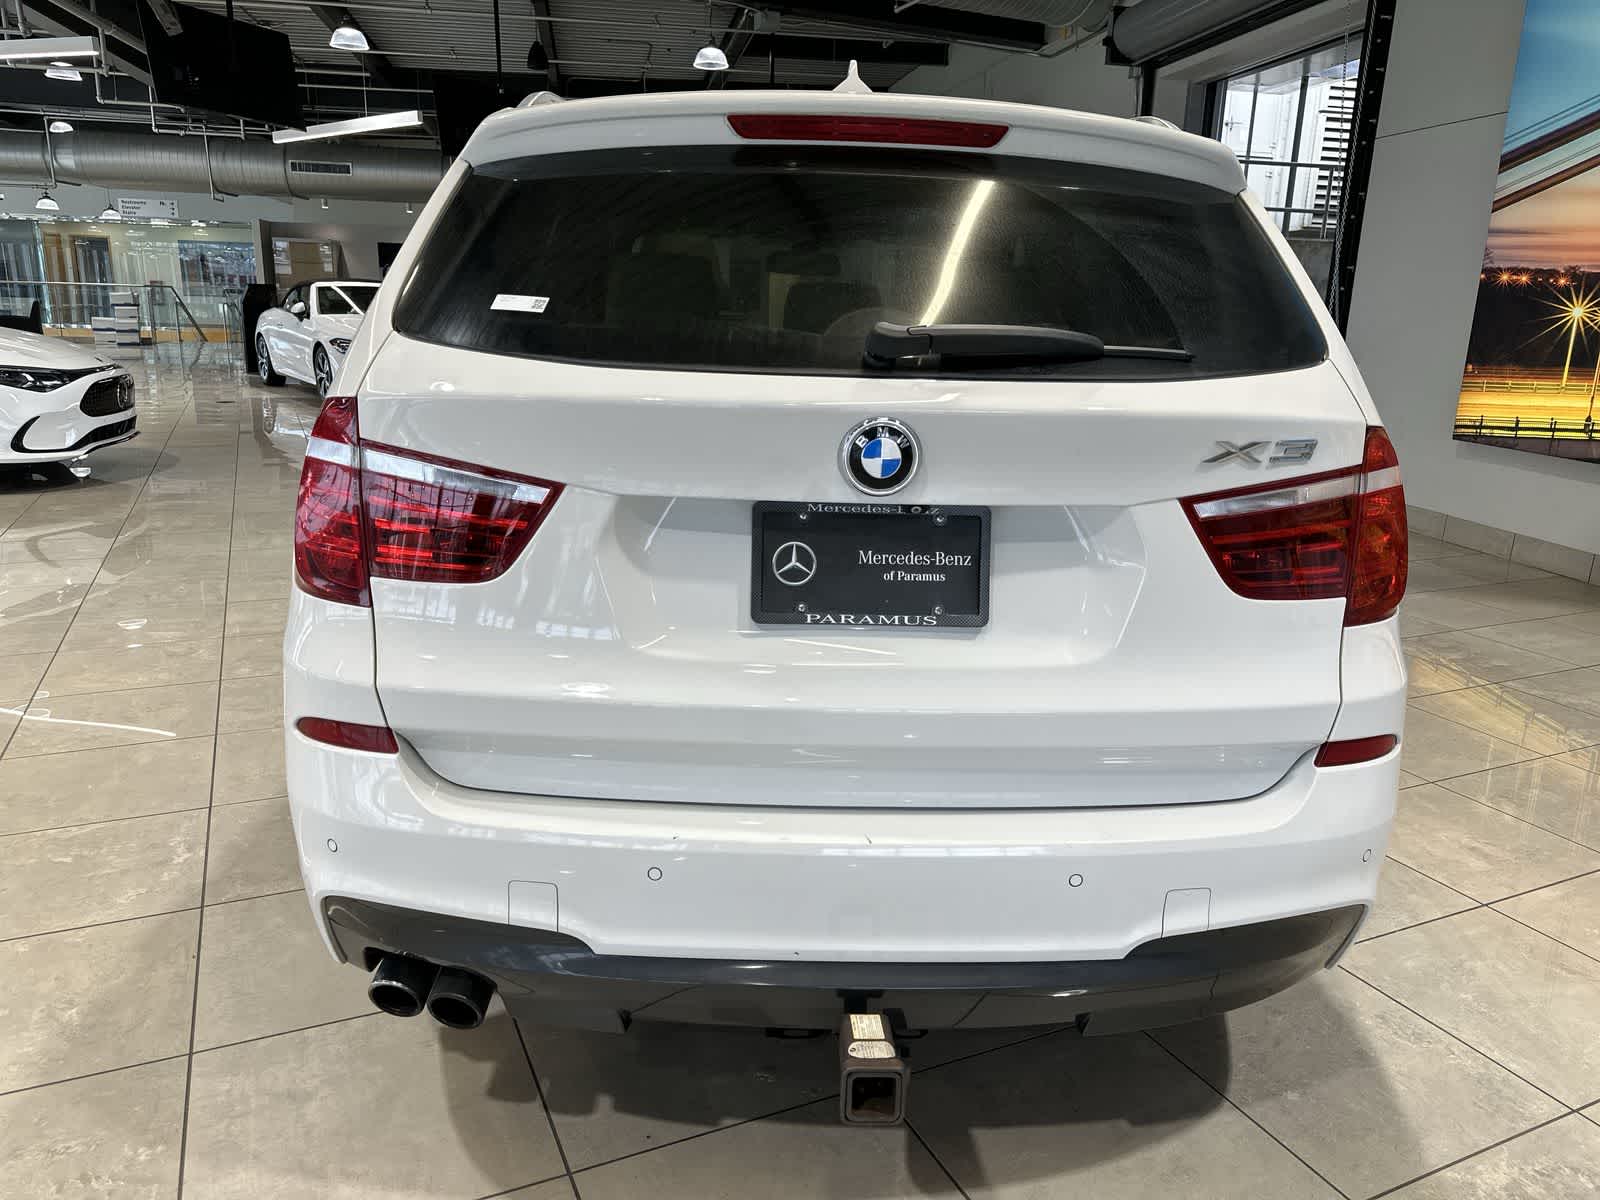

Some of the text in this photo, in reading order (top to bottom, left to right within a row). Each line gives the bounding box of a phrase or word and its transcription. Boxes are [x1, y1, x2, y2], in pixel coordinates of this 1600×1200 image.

[855, 427, 910, 449] BMW
[1202, 439, 1318, 464] X3
[858, 550, 972, 567] Mercedes-Benz
[883, 571, 946, 582] of Paramus
[806, 614, 937, 626] PARAMUS
